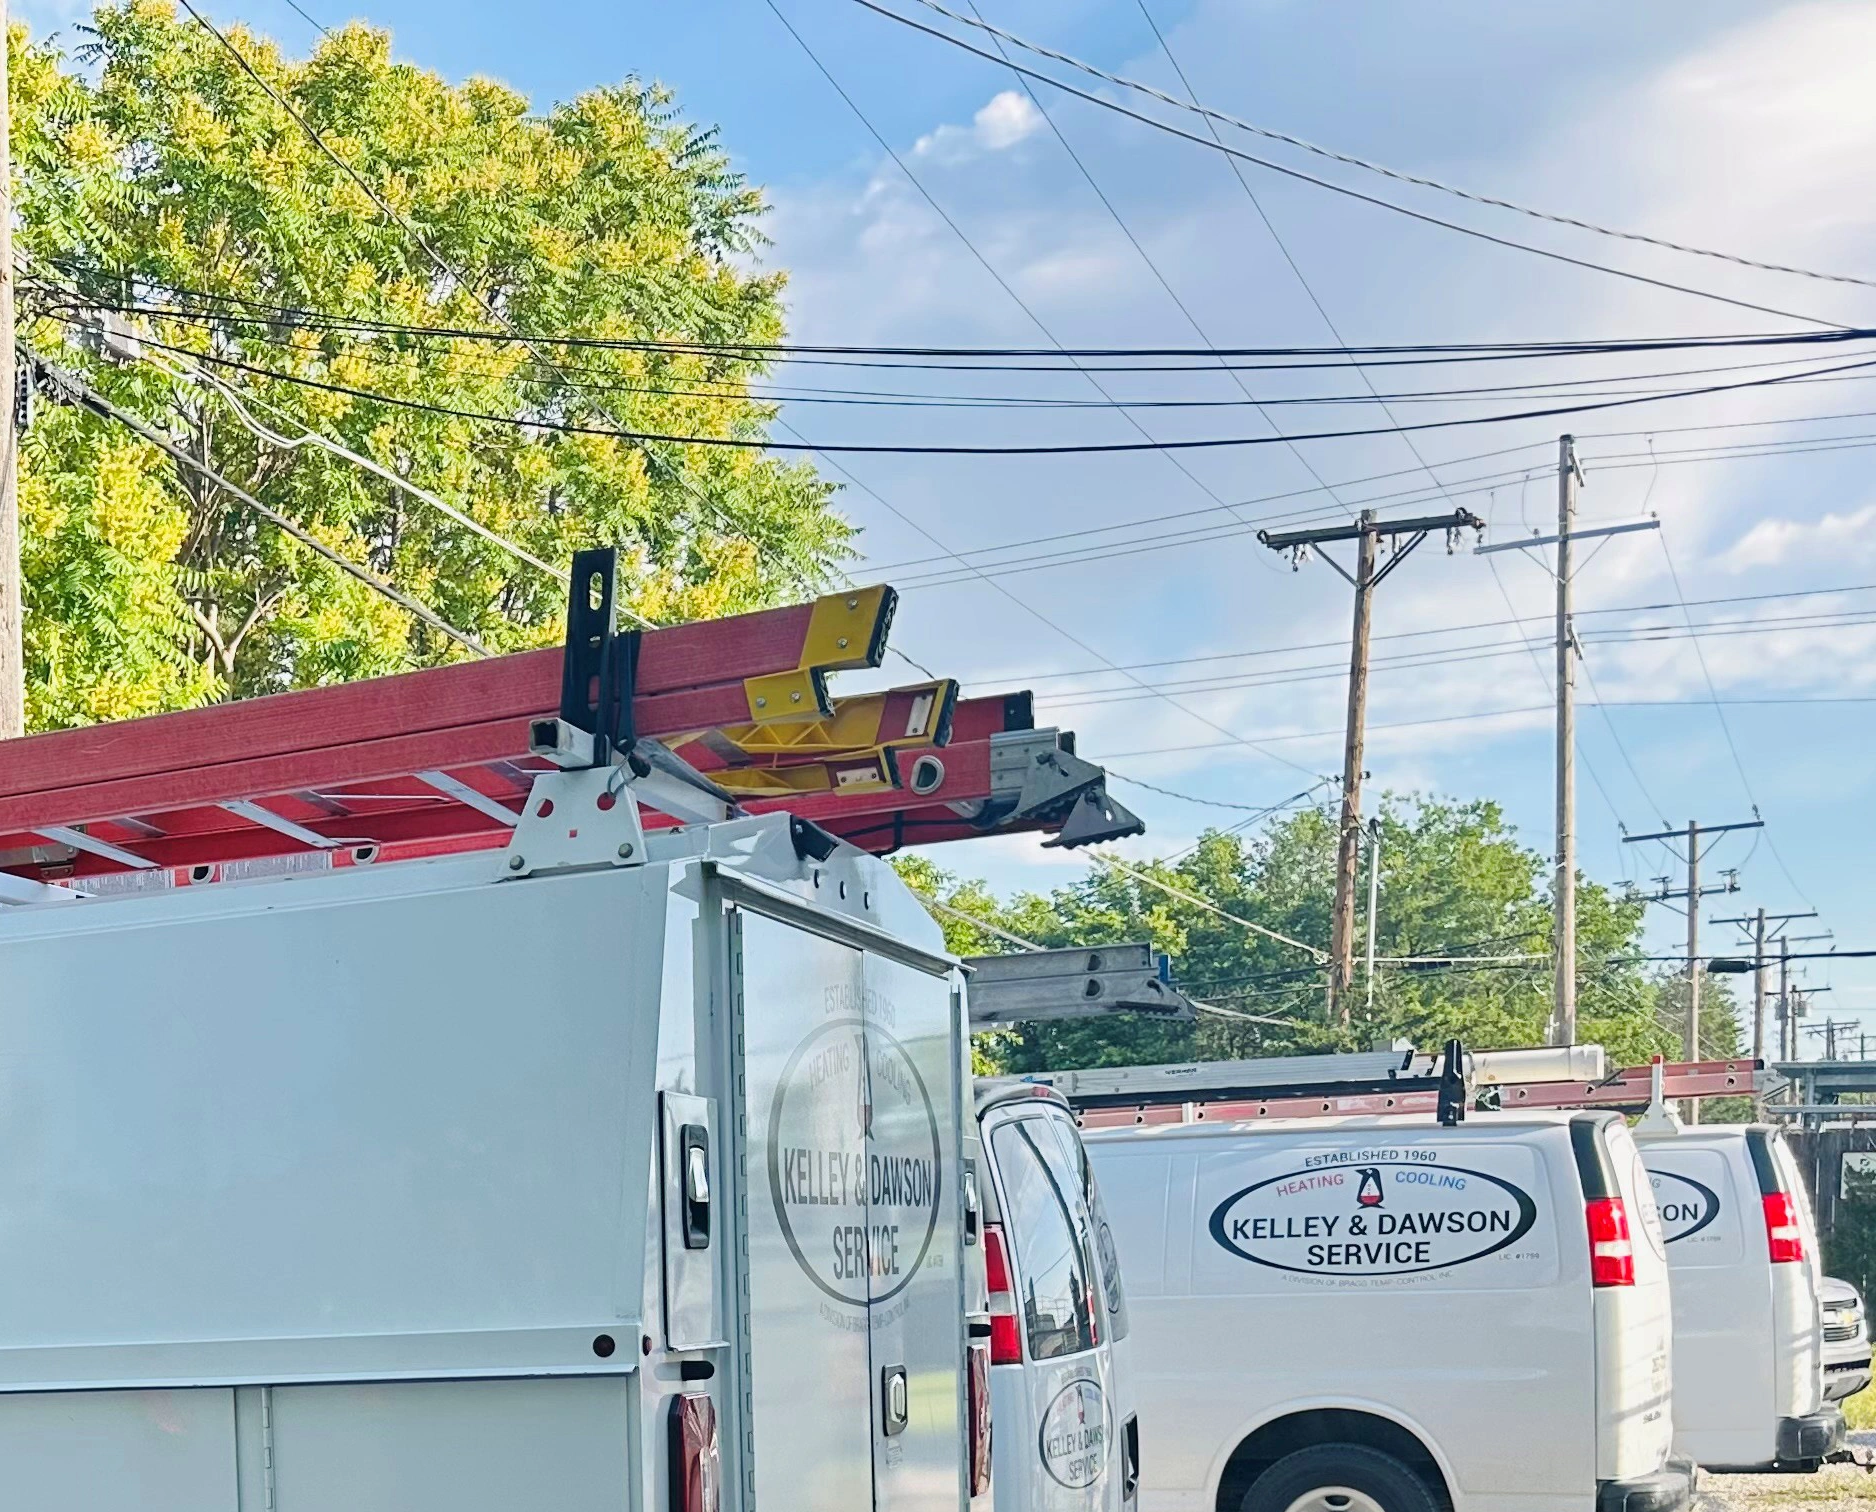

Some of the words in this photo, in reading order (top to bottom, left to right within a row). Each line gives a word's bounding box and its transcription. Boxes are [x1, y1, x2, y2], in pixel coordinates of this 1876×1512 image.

[1304, 1150, 1399, 1167] ESTABLISHED
[1403, 1150, 1437, 1162] 1960
[783, 1147, 850, 1206] KELLEY
[854, 1153, 868, 1207] &
[871, 1154, 932, 1207] DAWSON
[1275, 1173, 1344, 1198] HEATING
[1395, 1170, 1467, 1191] COOLING
[1232, 1215, 1340, 1240] KELLEY
[1348, 1215, 1367, 1236] &
[1378, 1210, 1511, 1235] DAWSON
[833, 1225, 900, 1280] SERVICE
[1307, 1241, 1431, 1266] SERVICE
[1045, 1433, 1076, 1461] KELLEY
